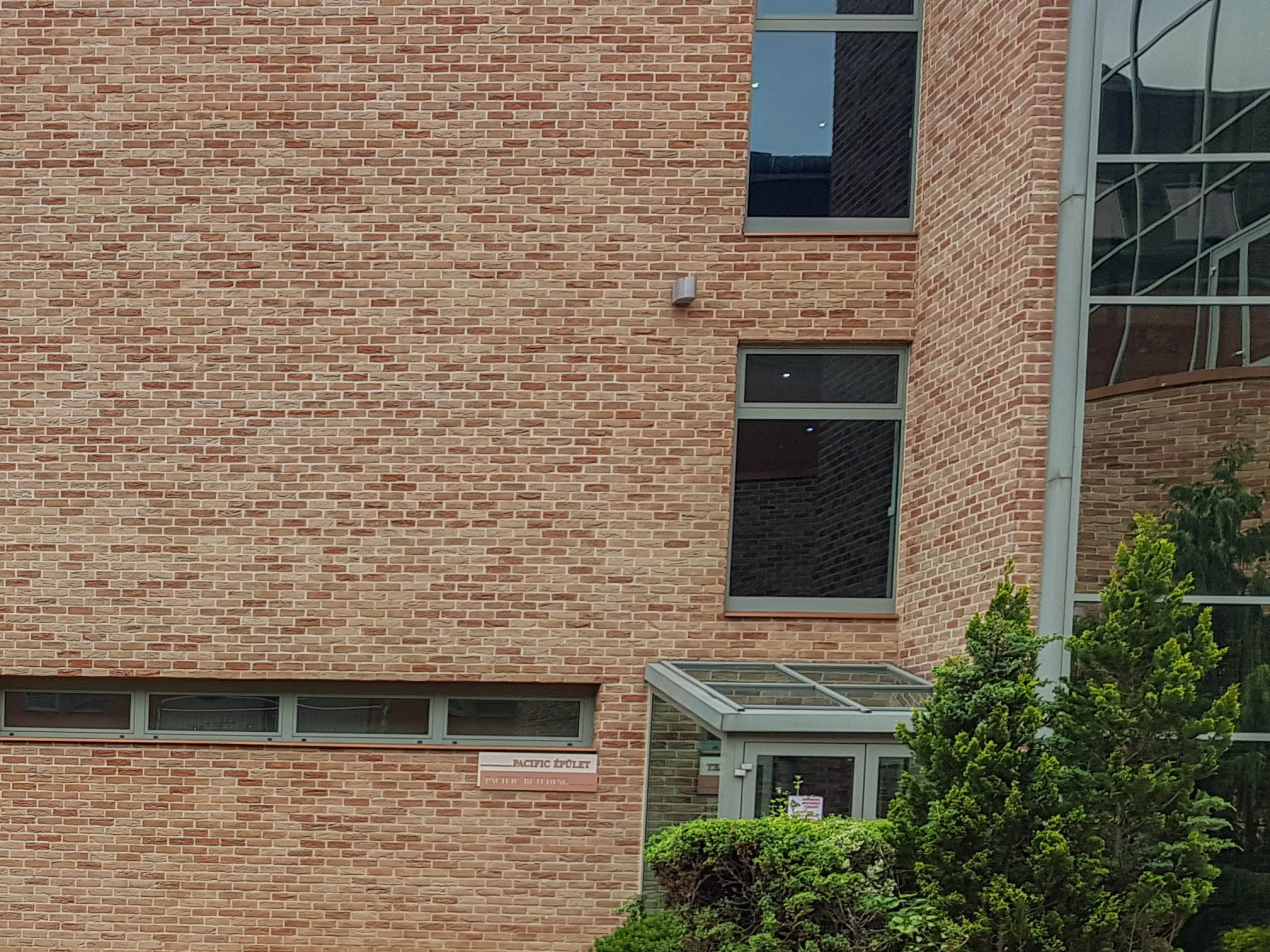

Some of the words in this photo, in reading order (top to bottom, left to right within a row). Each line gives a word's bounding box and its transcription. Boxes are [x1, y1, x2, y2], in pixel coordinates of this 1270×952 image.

[512, 759, 551, 768] PACIFIC
[553, 758, 591, 769] ÉPÜLET
[484, 776, 519, 785] PACIFIC
